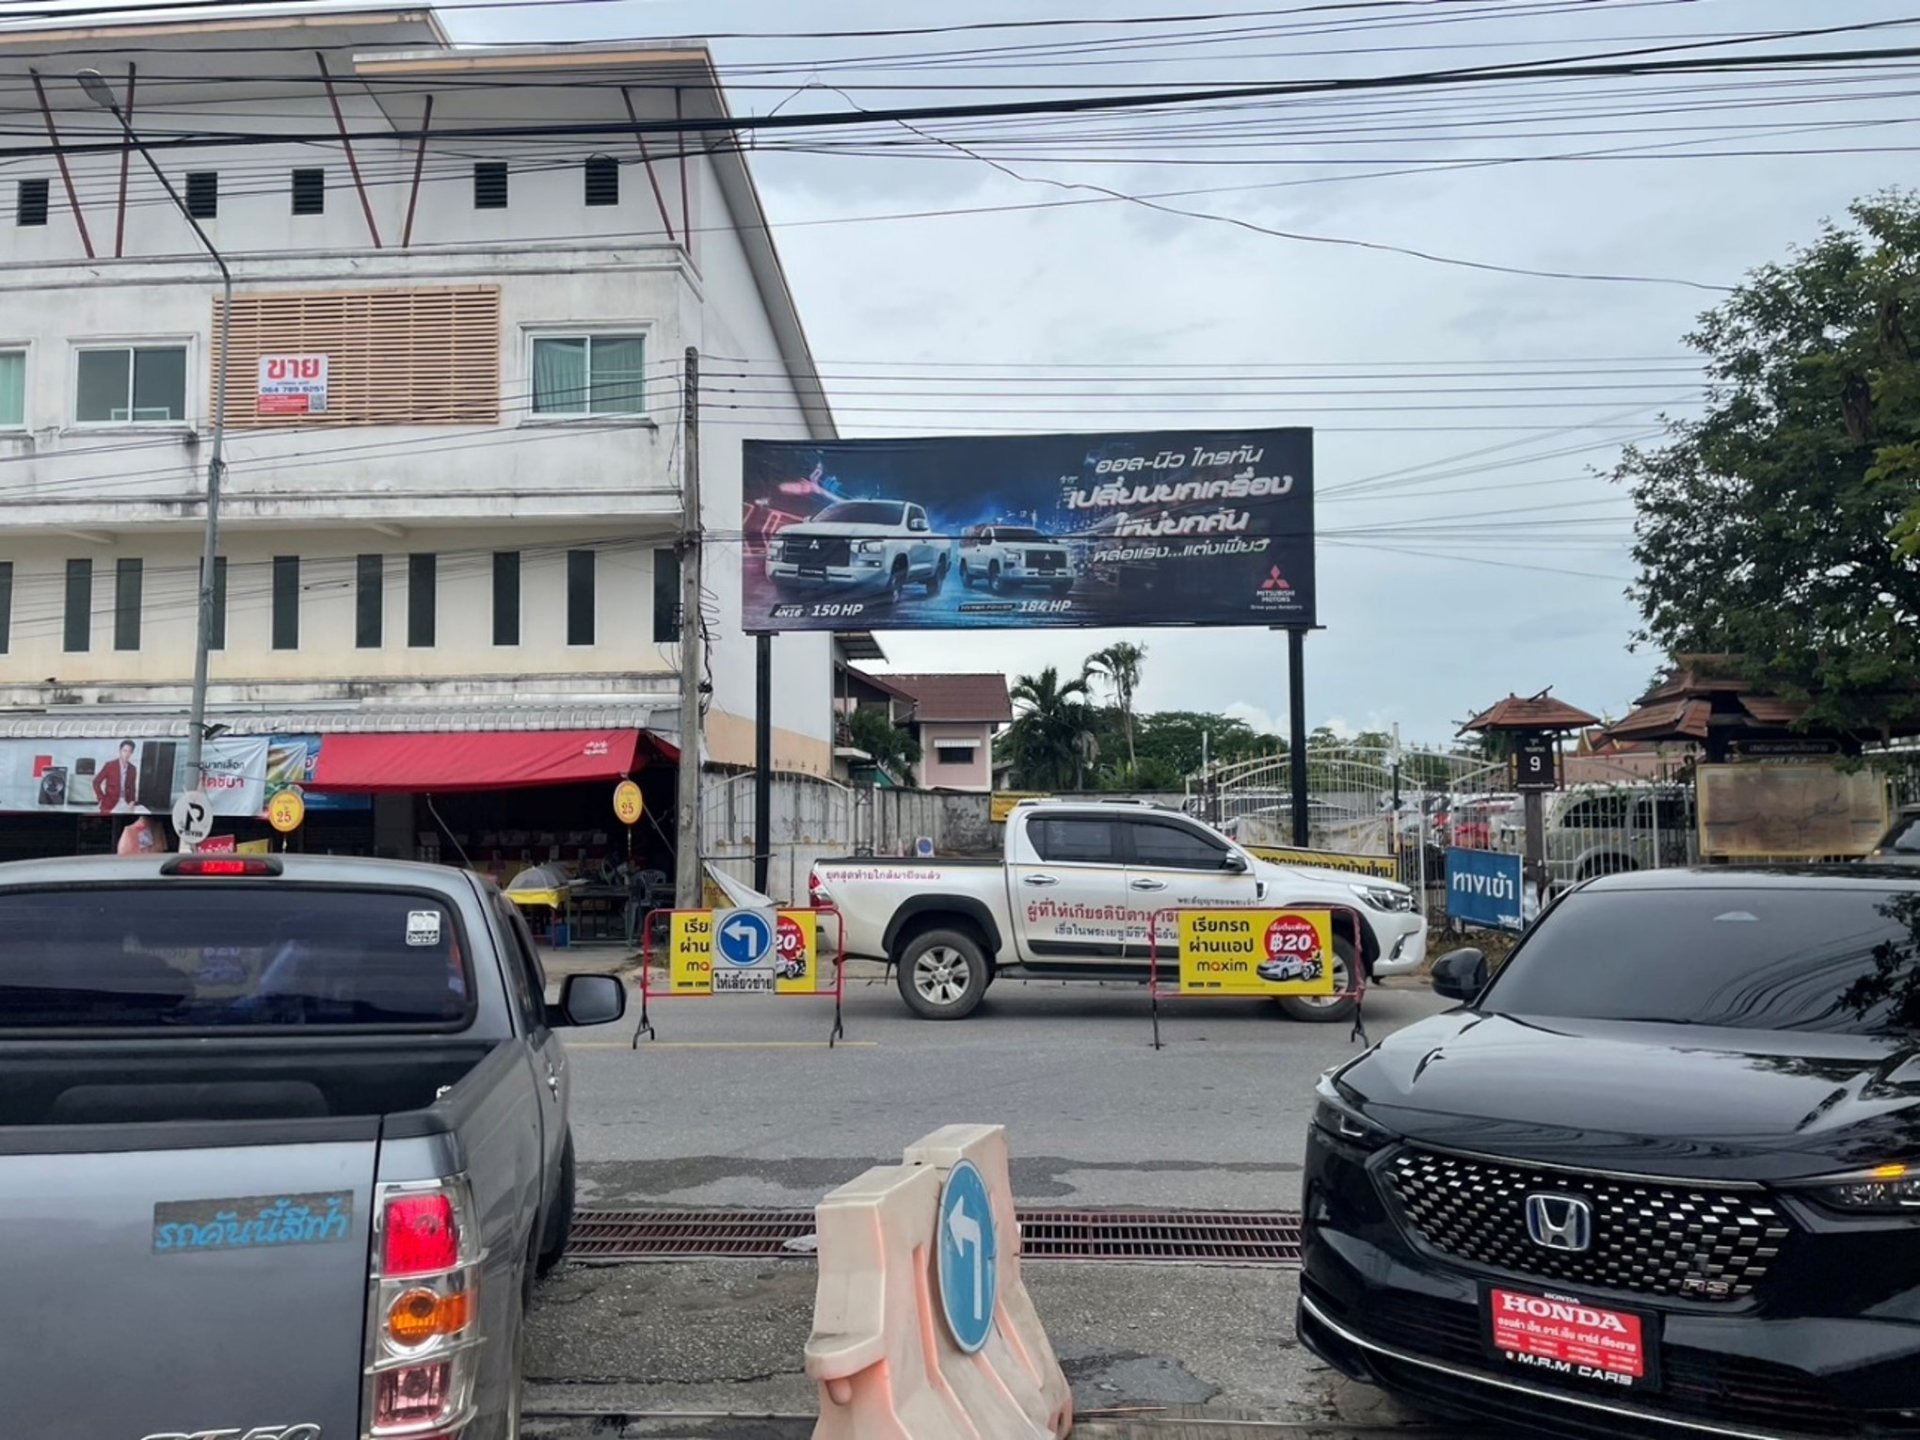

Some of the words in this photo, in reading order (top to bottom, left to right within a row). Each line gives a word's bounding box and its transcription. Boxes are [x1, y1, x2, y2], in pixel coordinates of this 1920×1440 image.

[267, 358, 320, 379] ขาย
[1095, 451, 1186, 474] ออล-นิว
[1190, 444, 1264, 467] ไทรทัน
[1066, 466, 1294, 509] เปลี่ยนยกเครื่อง
[1114, 507, 1250, 537] ใหม่ยกคัน
[811, 604, 840, 617] 150
[841, 604, 864, 616] HP
[1018, 600, 1047, 612] 184
[1049, 600, 1072, 612] HP
[1530, 755, 1541, 772] 9
[276, 810, 291, 823] 25
[621, 802, 634, 815] 25
[1453, 870, 1513, 900] ทางเข้า
[1192, 916, 1250, 932] เรียกรถ
[1189, 936, 1255, 953] ผ่านแอป
[1197, 958, 1248, 972] maxim
[155, 1196, 346, 1249] รถคันนี้สีฟ้า
[1543, 1292, 1581, 1305] HONDA
[1502, 1294, 1628, 1333] HONDA
[1578, 1365, 1633, 1386] CARS
